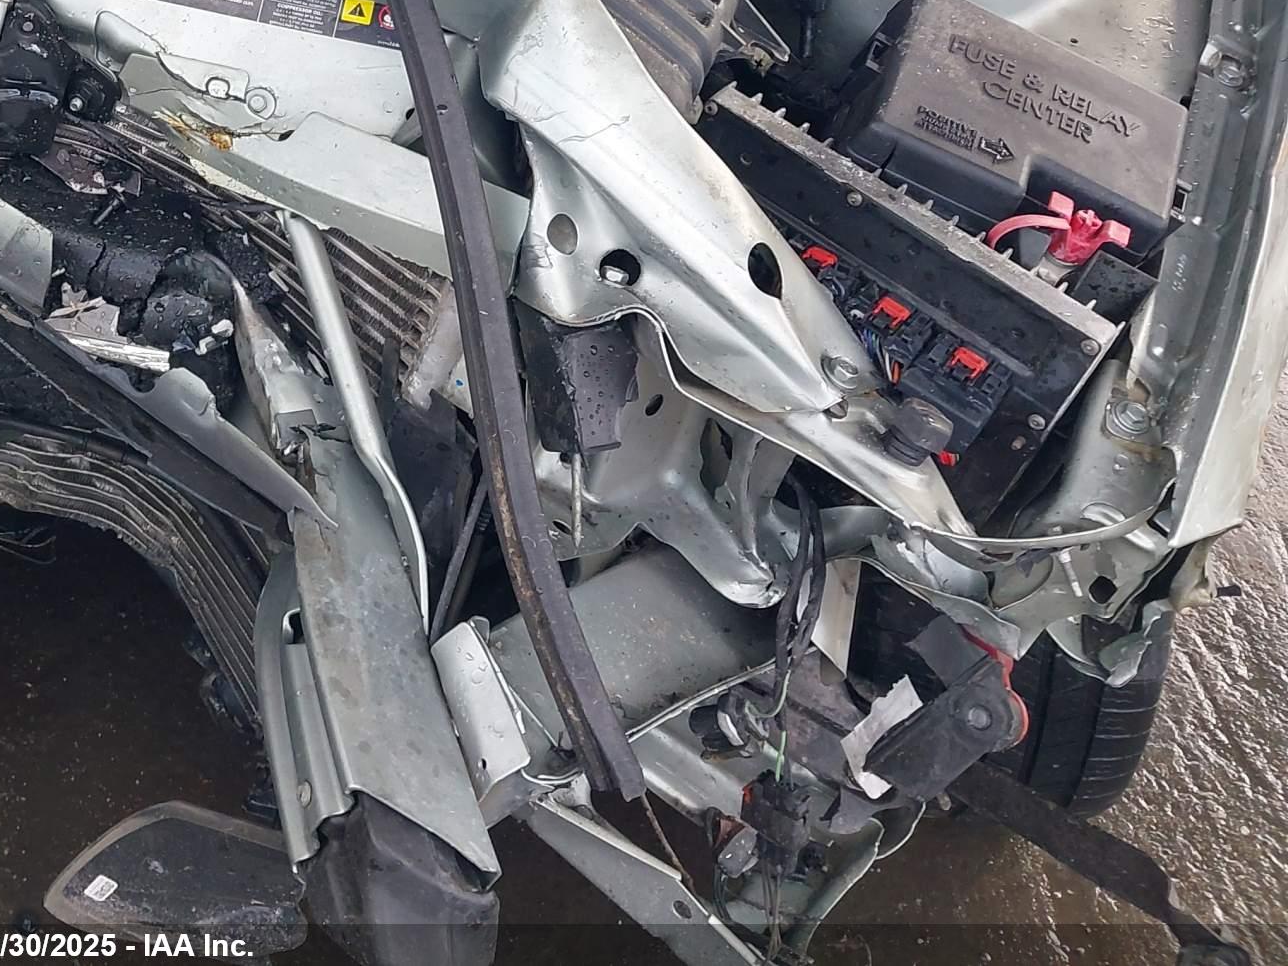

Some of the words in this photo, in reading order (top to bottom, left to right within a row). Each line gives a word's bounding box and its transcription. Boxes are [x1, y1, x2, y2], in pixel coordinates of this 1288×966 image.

[948, 33, 1016, 80] FUSE
[1022, 73, 1044, 94] &
[1052, 83, 1141, 137] RELAY
[982, 80, 1094, 144] CENTER
